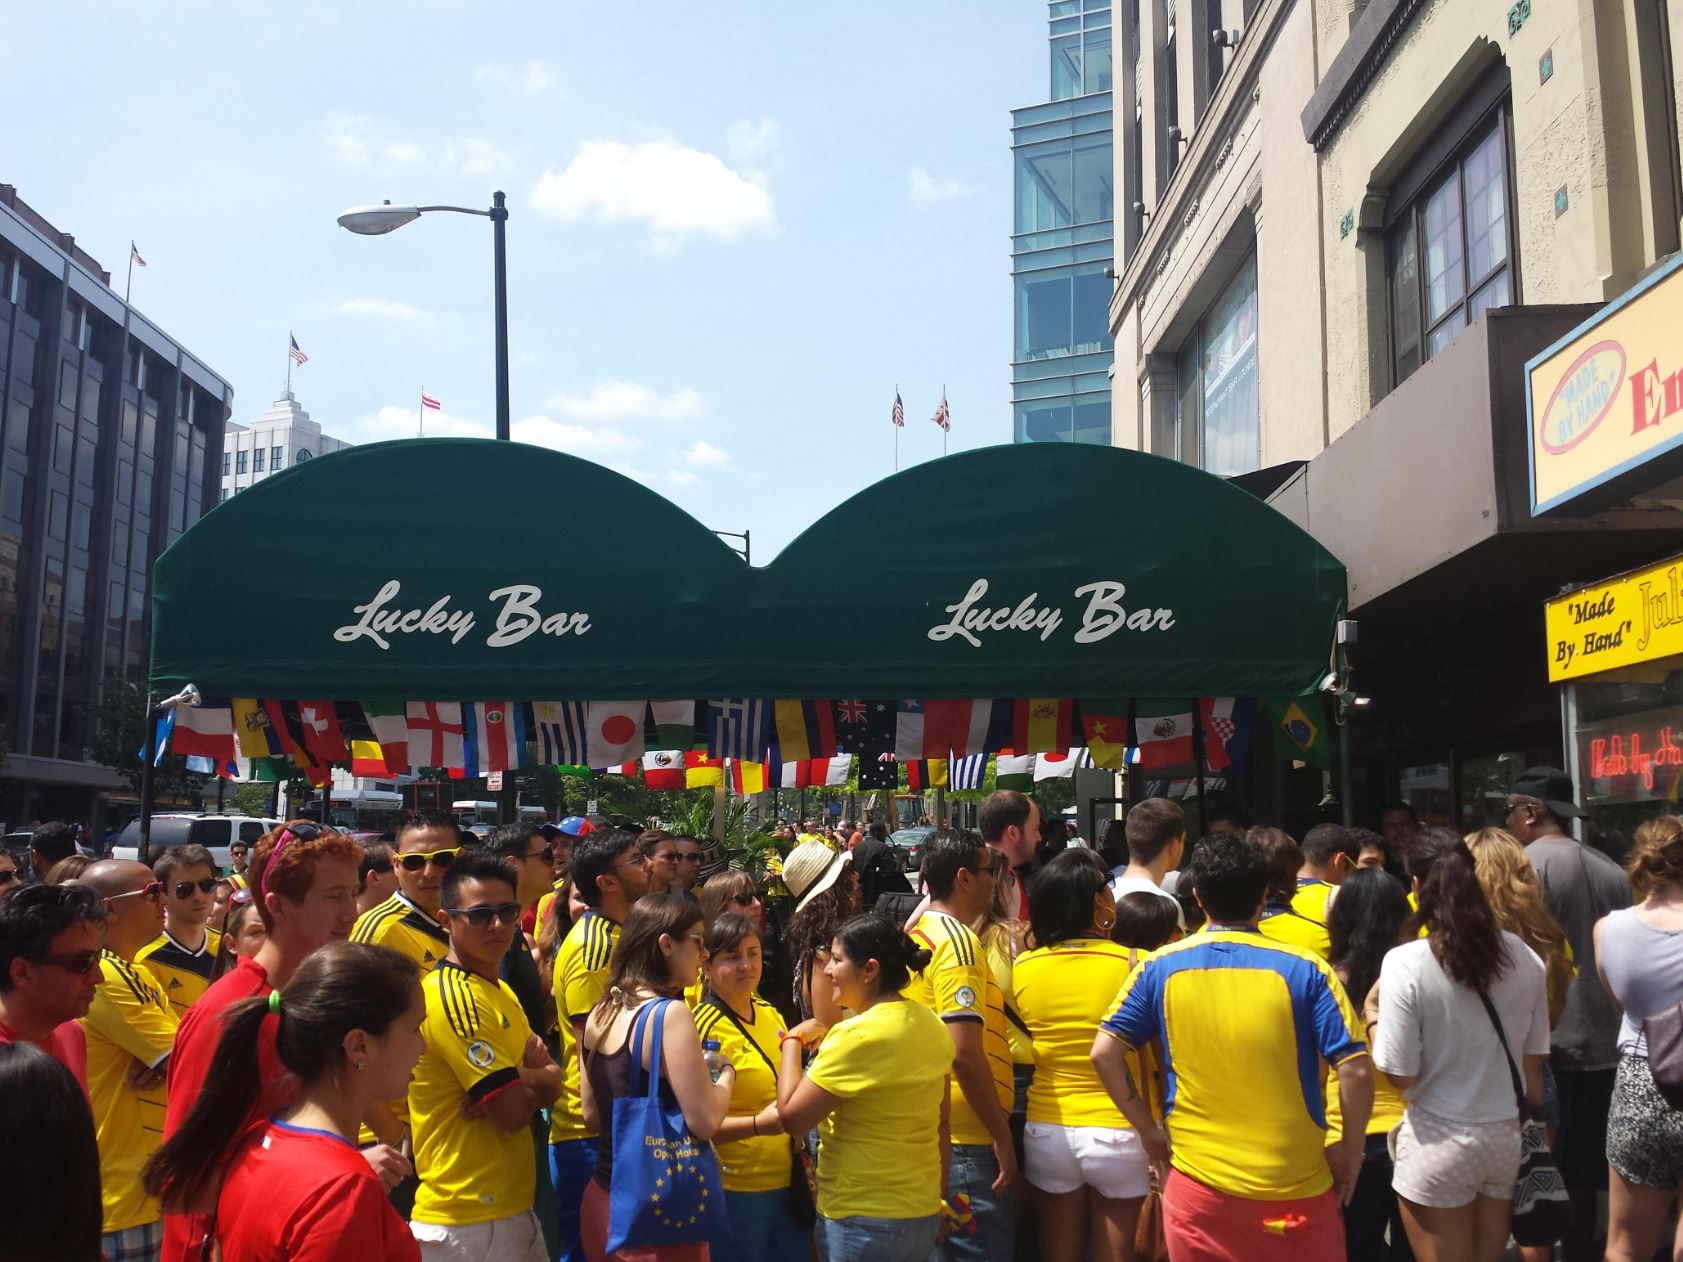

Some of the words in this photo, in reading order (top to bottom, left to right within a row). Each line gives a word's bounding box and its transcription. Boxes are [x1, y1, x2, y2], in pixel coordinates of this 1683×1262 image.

[1558, 410, 1573, 443] BY
[333, 580, 475, 650] Lucky
[487, 584, 592, 648] Bar
[927, 578, 1063, 648] Lucky
[1073, 581, 1176, 644] Bar
[1569, 591, 1615, 624] "Made
[1637, 567, 1683, 651] Jul
[1582, 620, 1632, 656] Hand"
